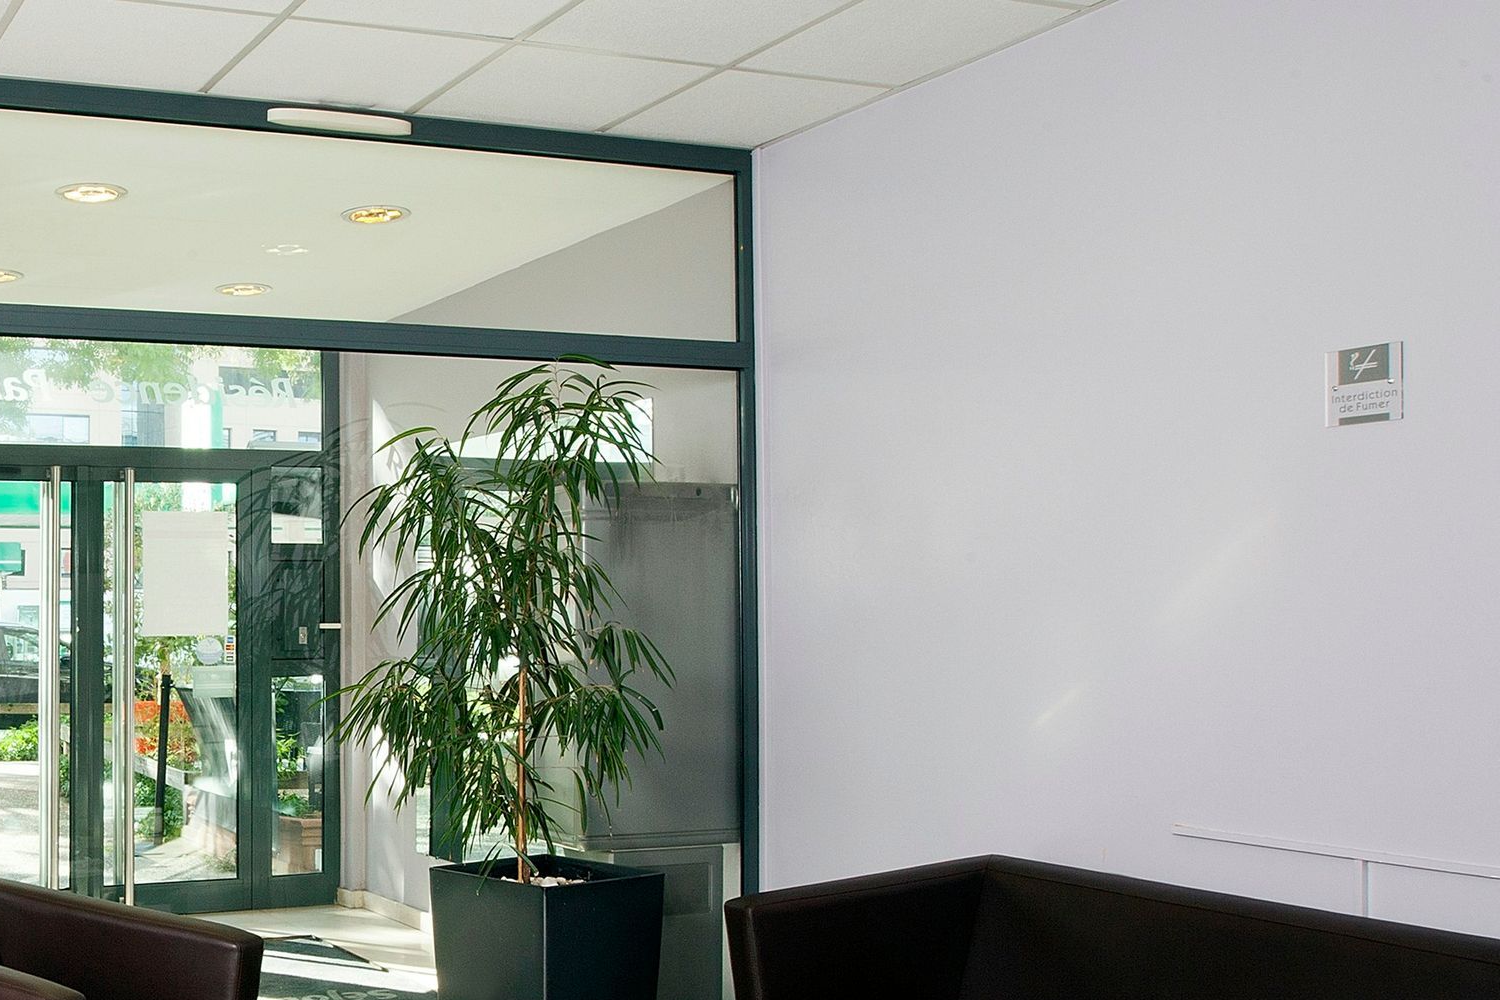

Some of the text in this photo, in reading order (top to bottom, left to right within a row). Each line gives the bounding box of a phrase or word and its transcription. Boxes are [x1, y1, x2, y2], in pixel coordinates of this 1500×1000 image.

[1331, 388, 1397, 404] Interdiction
[1339, 400, 1390, 413] de Fumer
